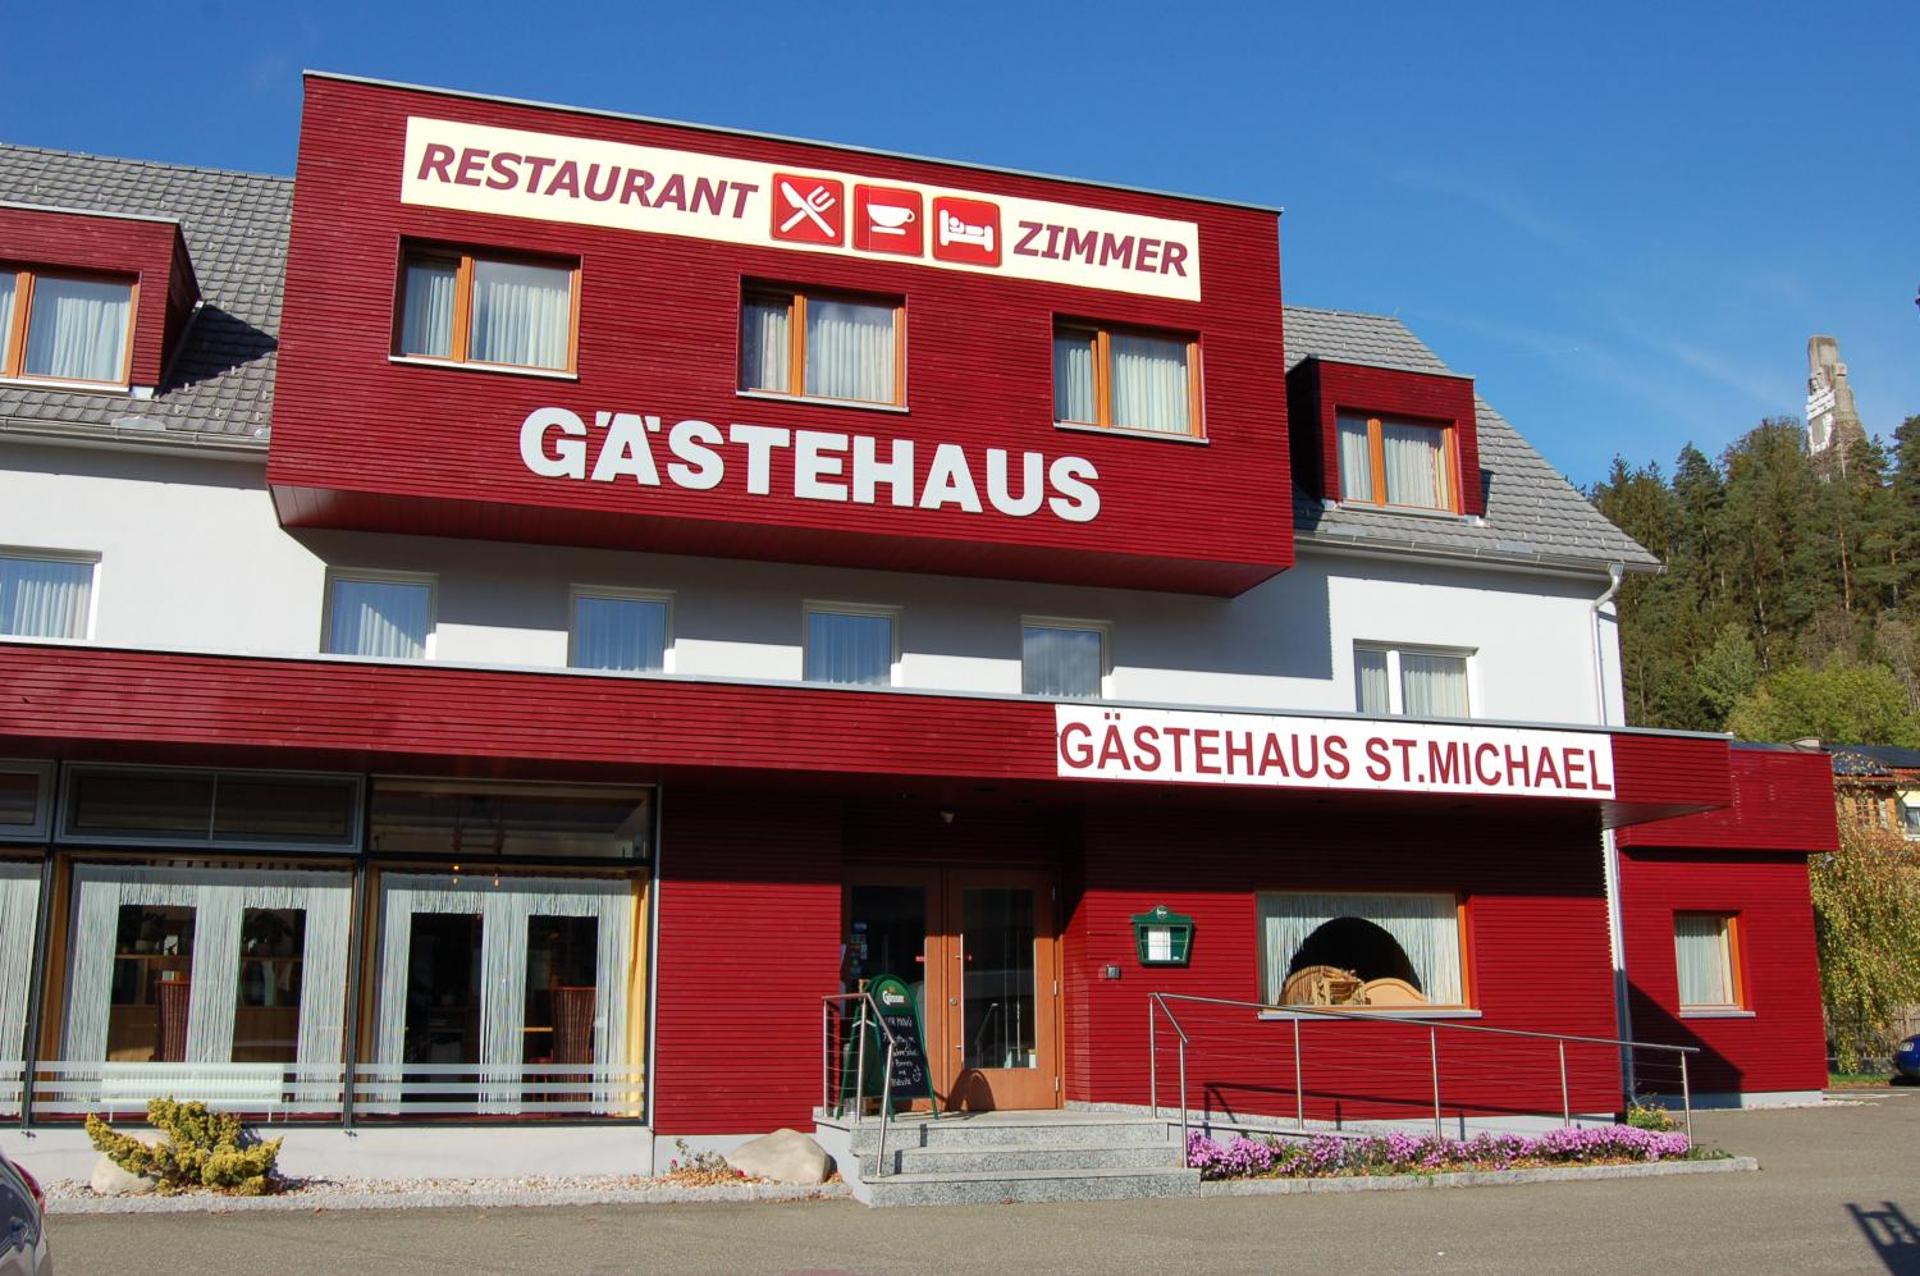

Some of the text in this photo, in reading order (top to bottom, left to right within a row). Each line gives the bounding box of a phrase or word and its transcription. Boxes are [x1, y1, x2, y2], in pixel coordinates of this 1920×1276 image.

[417, 143, 1188, 277] RESTAURANT ZIMMER
[519, 407, 1101, 522] GÄSTEHAUS
[1059, 712, 1612, 791] GÄSTEHAUS ST.MICHAEL
